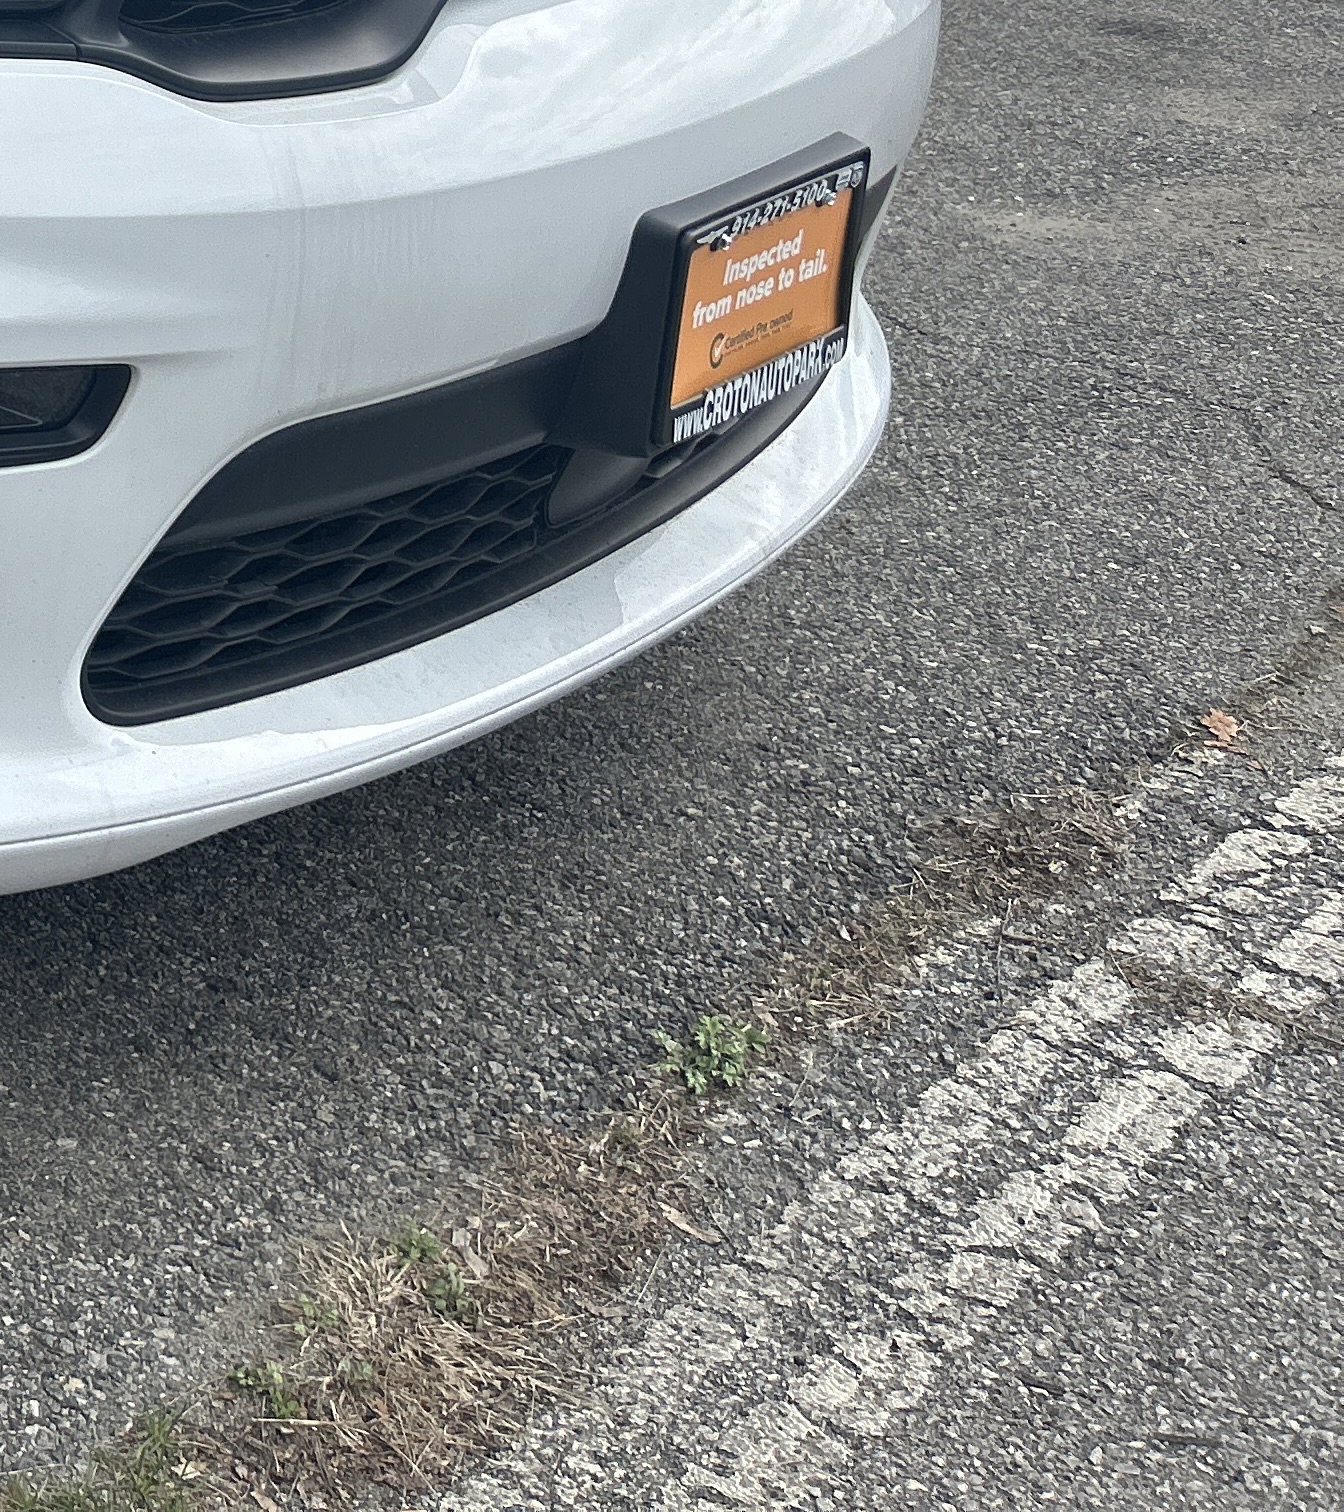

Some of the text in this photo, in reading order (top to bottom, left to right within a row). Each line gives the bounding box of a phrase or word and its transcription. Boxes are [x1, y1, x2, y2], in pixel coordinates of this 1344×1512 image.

[692, 248, 828, 329] from nose to tail.
[722, 229, 805, 287] Inspected
